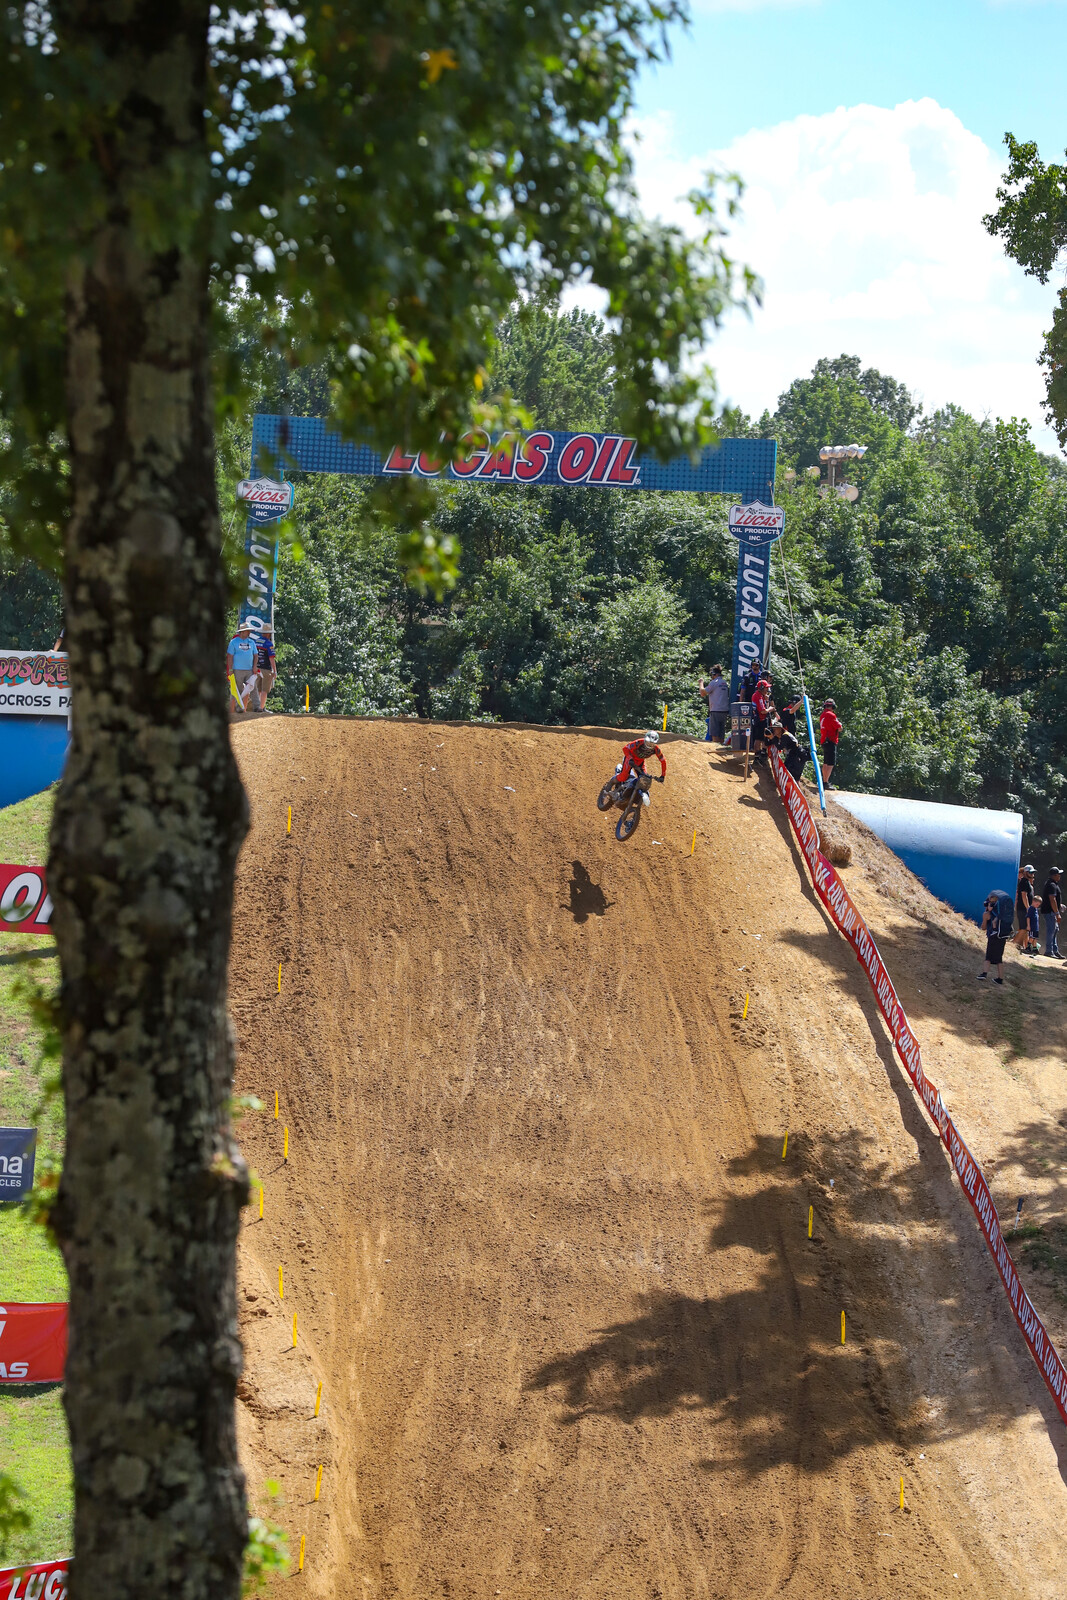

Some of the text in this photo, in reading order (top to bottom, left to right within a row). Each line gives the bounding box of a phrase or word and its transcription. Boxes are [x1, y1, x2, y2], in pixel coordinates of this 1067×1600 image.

[557, 433, 642, 486] OIL
[243, 489, 288, 503] LUCAS
[251, 503, 287, 511] PRODUCTS
[734, 514, 781, 527] LUCAS
[744, 527, 780, 535] PRODUCTS
[740, 553, 765, 636] LUCAS
[787, 784, 808, 829] LUCAS
[815, 861, 831, 893] OIL
[827, 880, 857, 937] LUCAS OIL
[855, 923, 880, 985] LUCAS OIL
[877, 972, 894, 1019] LUCAS
[898, 1025, 920, 1073] LUCAS
[964, 1162, 978, 1197] OIL
[975, 1182, 993, 1233] LUCAS
[1018, 1293, 1044, 1362] LUCAS OIL
[1043, 1344, 1063, 1397] LUCAS
